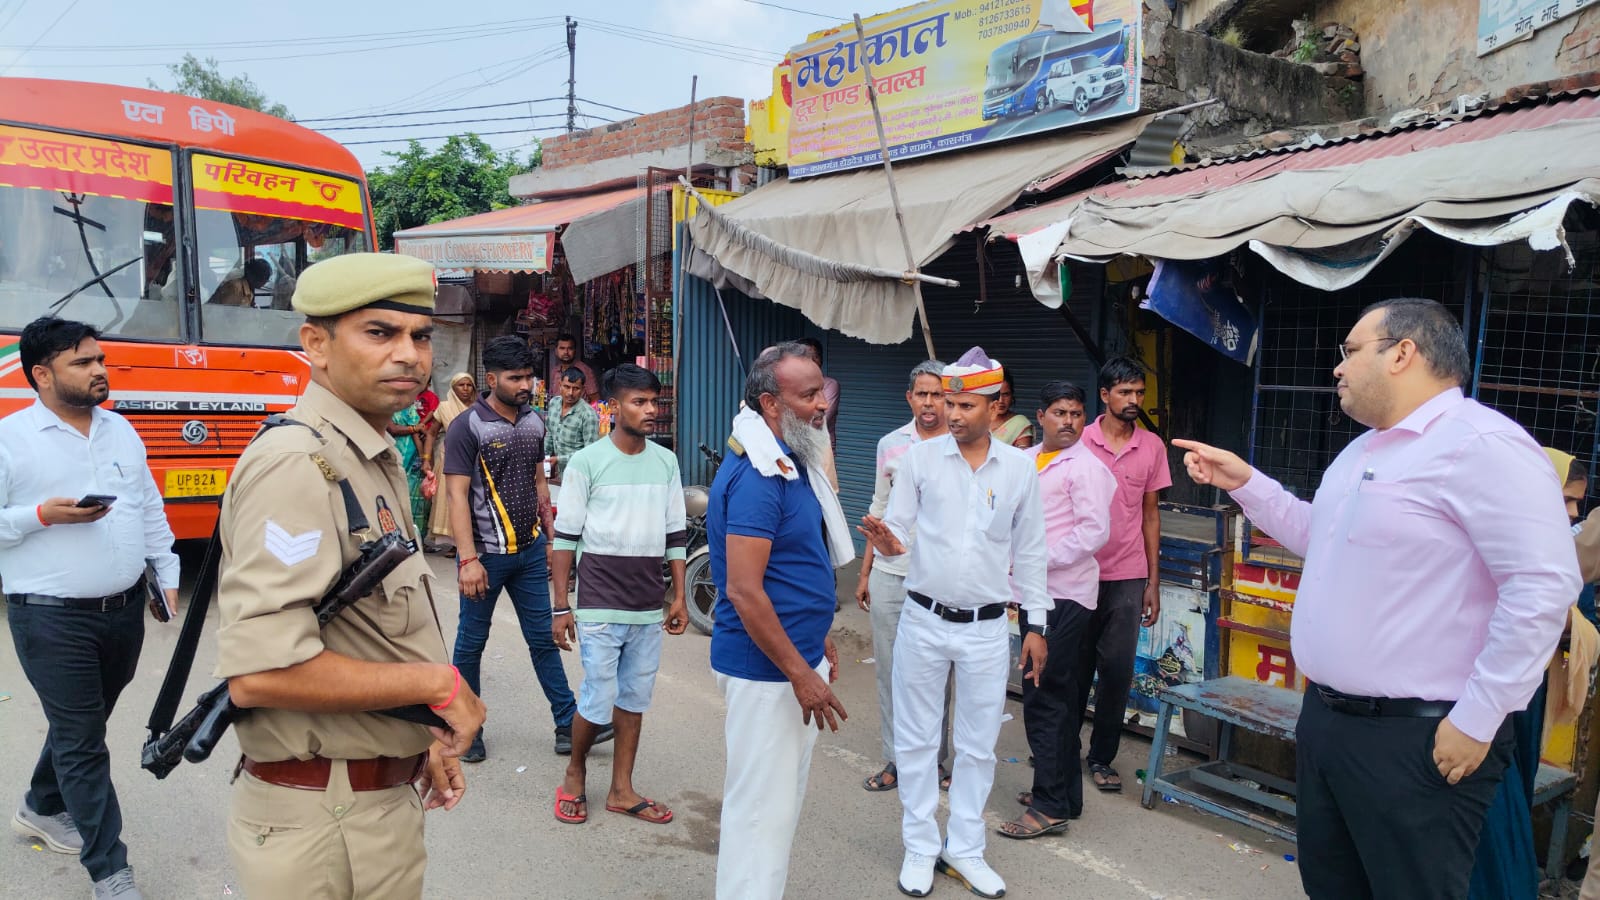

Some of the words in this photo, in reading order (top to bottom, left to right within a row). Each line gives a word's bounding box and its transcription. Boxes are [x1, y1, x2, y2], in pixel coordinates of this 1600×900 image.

[954, 8, 977, 20] Mob.:
[795, 12, 950, 88] महाकाल
[121, 99, 165, 125] एटा
[188, 105, 236, 136] डिपो
[937, 132, 973, 147] कासगंज
[18, 137, 86, 168] उत्तर
[90, 141, 152, 177] प्रदेश
[205, 162, 300, 192] परिवहन
[116, 400, 178, 410] ASHOK
[189, 402, 265, 411] LEYLAND
[177, 473, 216, 486] UP82A
